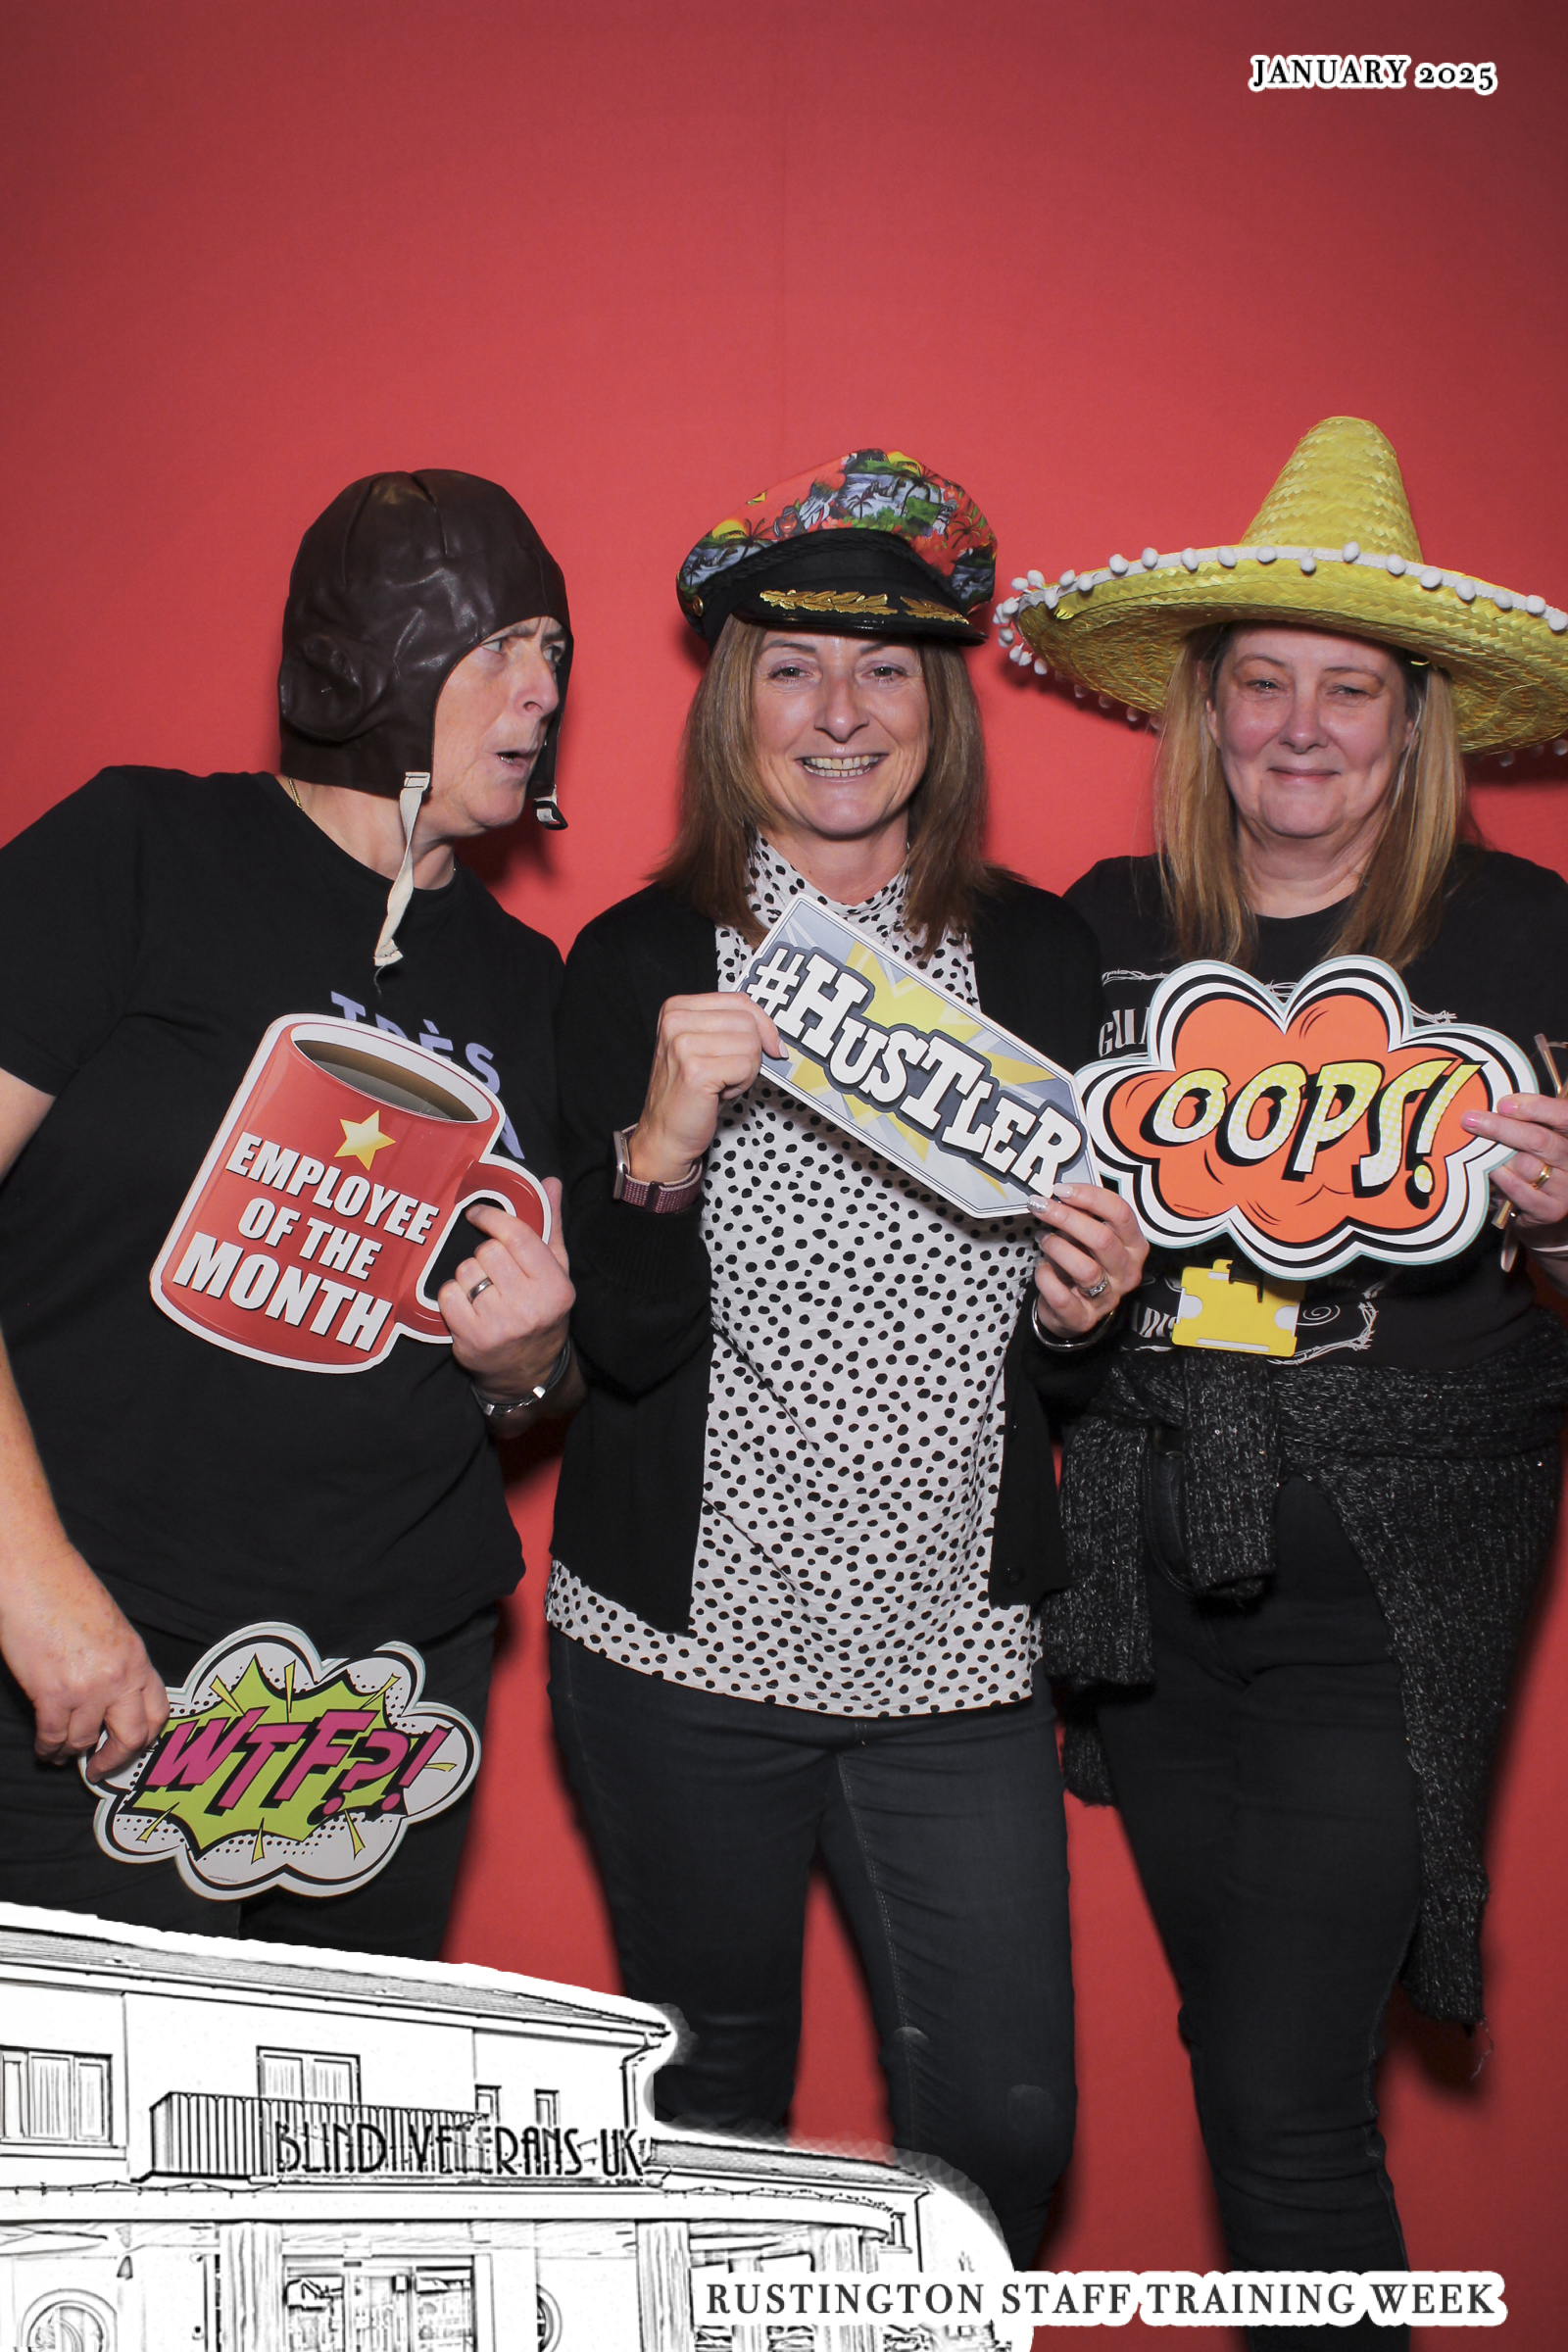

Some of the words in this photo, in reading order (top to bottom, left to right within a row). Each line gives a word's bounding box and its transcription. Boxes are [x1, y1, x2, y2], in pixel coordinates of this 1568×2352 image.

[224, 1130, 441, 1246] EMPLOYEE
[1145, 1059, 1486, 1205] OOPS!
[171, 1230, 394, 1352] MONTH
[237, 1196, 302, 1248] OF
[298, 1217, 383, 1281] THE
[143, 1705, 455, 1817] WTF?!
